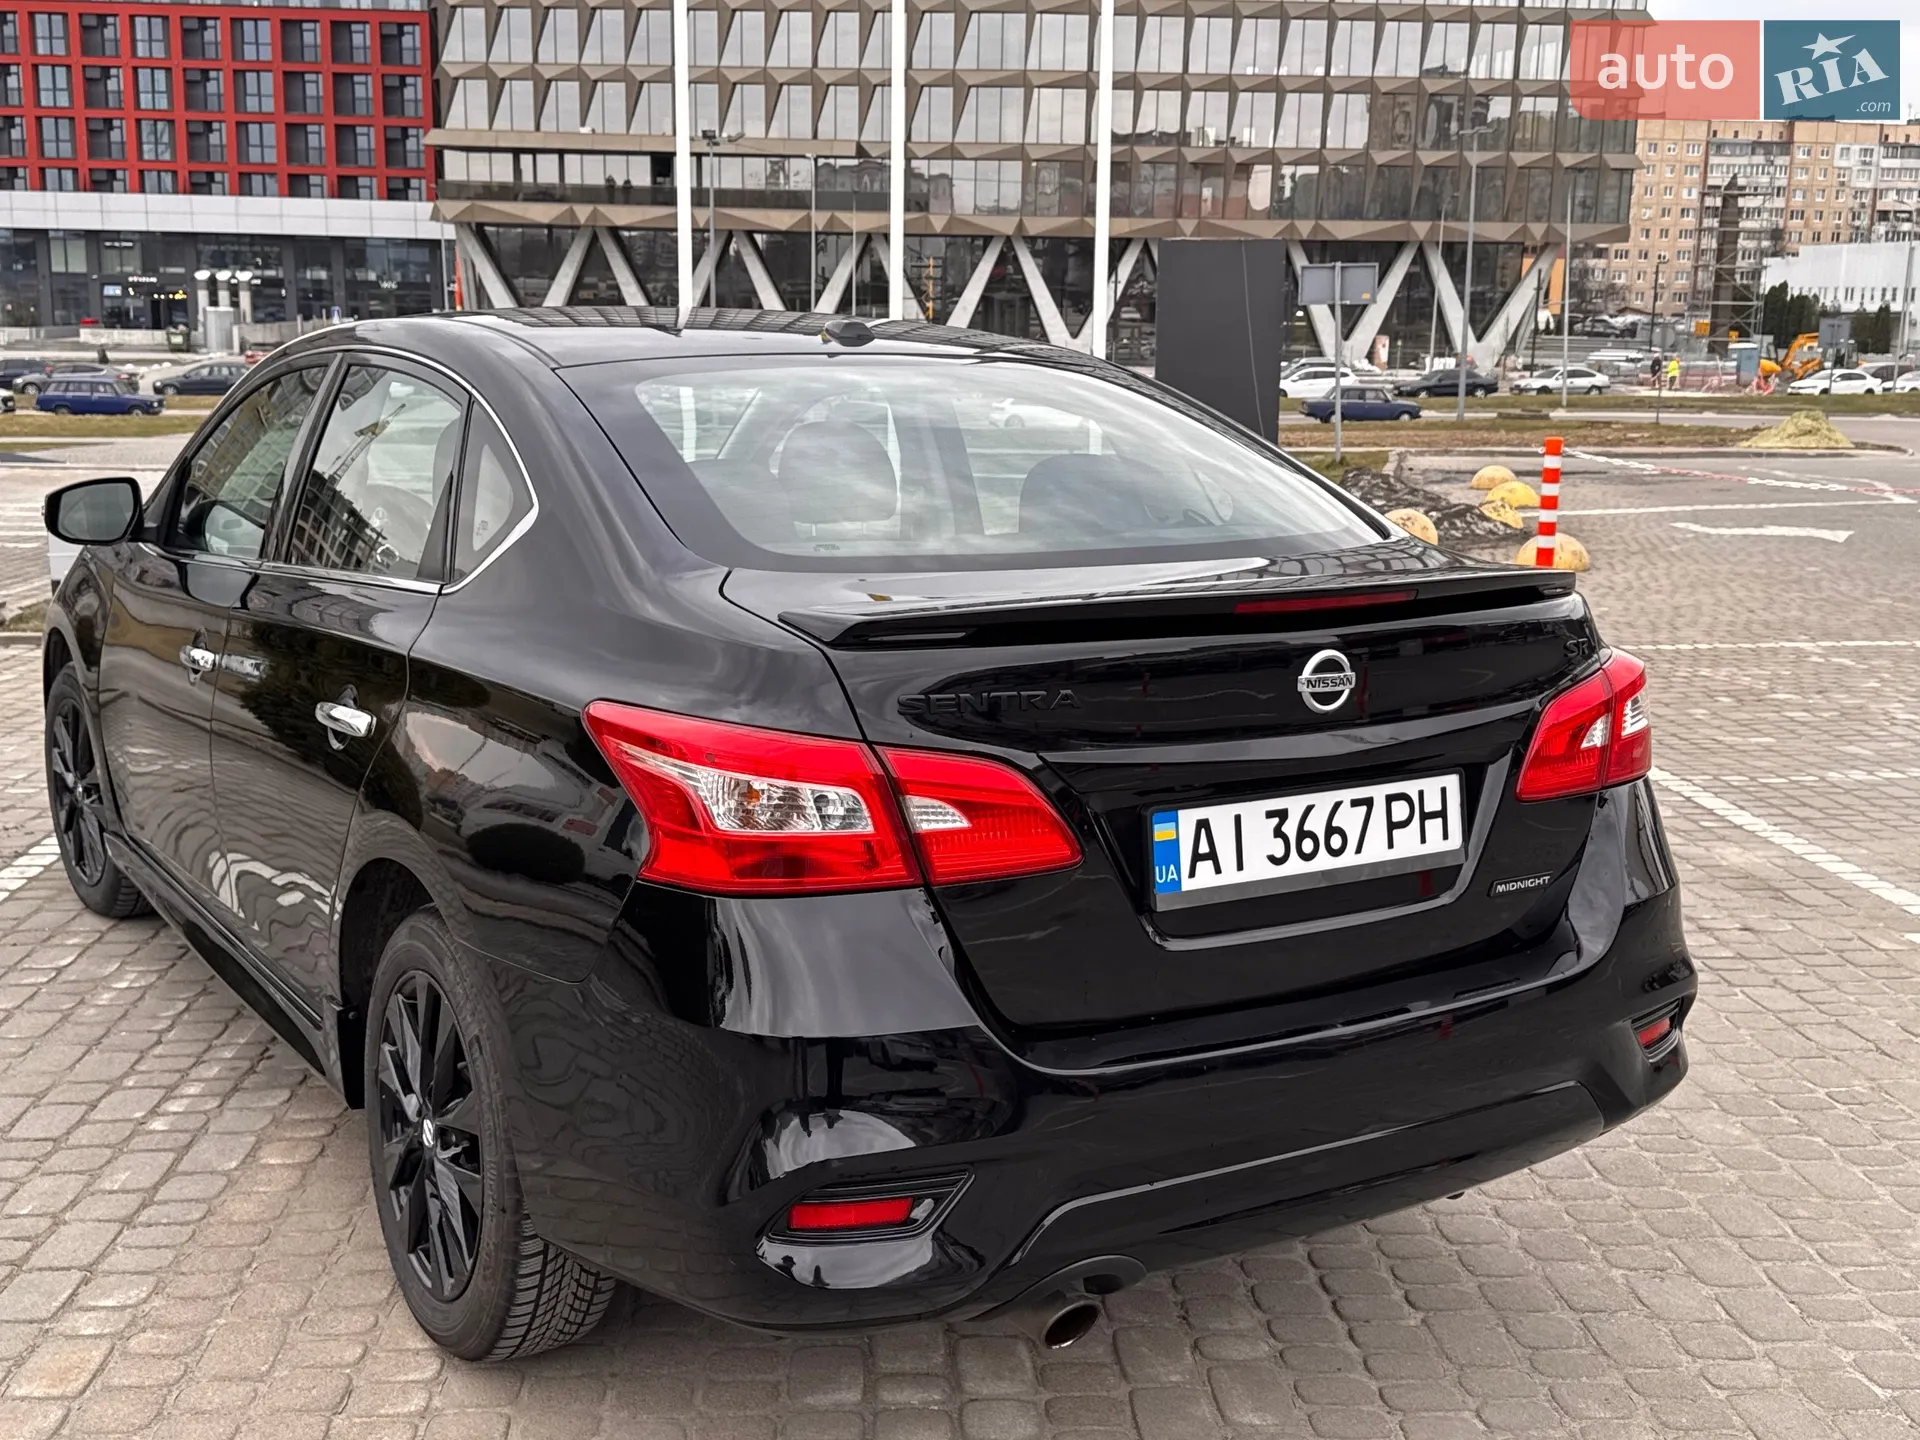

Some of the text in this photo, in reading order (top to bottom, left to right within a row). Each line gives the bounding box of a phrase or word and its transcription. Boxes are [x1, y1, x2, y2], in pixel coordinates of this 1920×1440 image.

[1306, 677, 1353, 689] NISSAN
[898, 689, 1082, 716] SENTRA
[1264, 795, 1374, 867] 3667
[1385, 785, 1449, 850] PH
[1155, 864, 1178, 883] UA
[1496, 876, 1551, 893] MIDNIGHT
